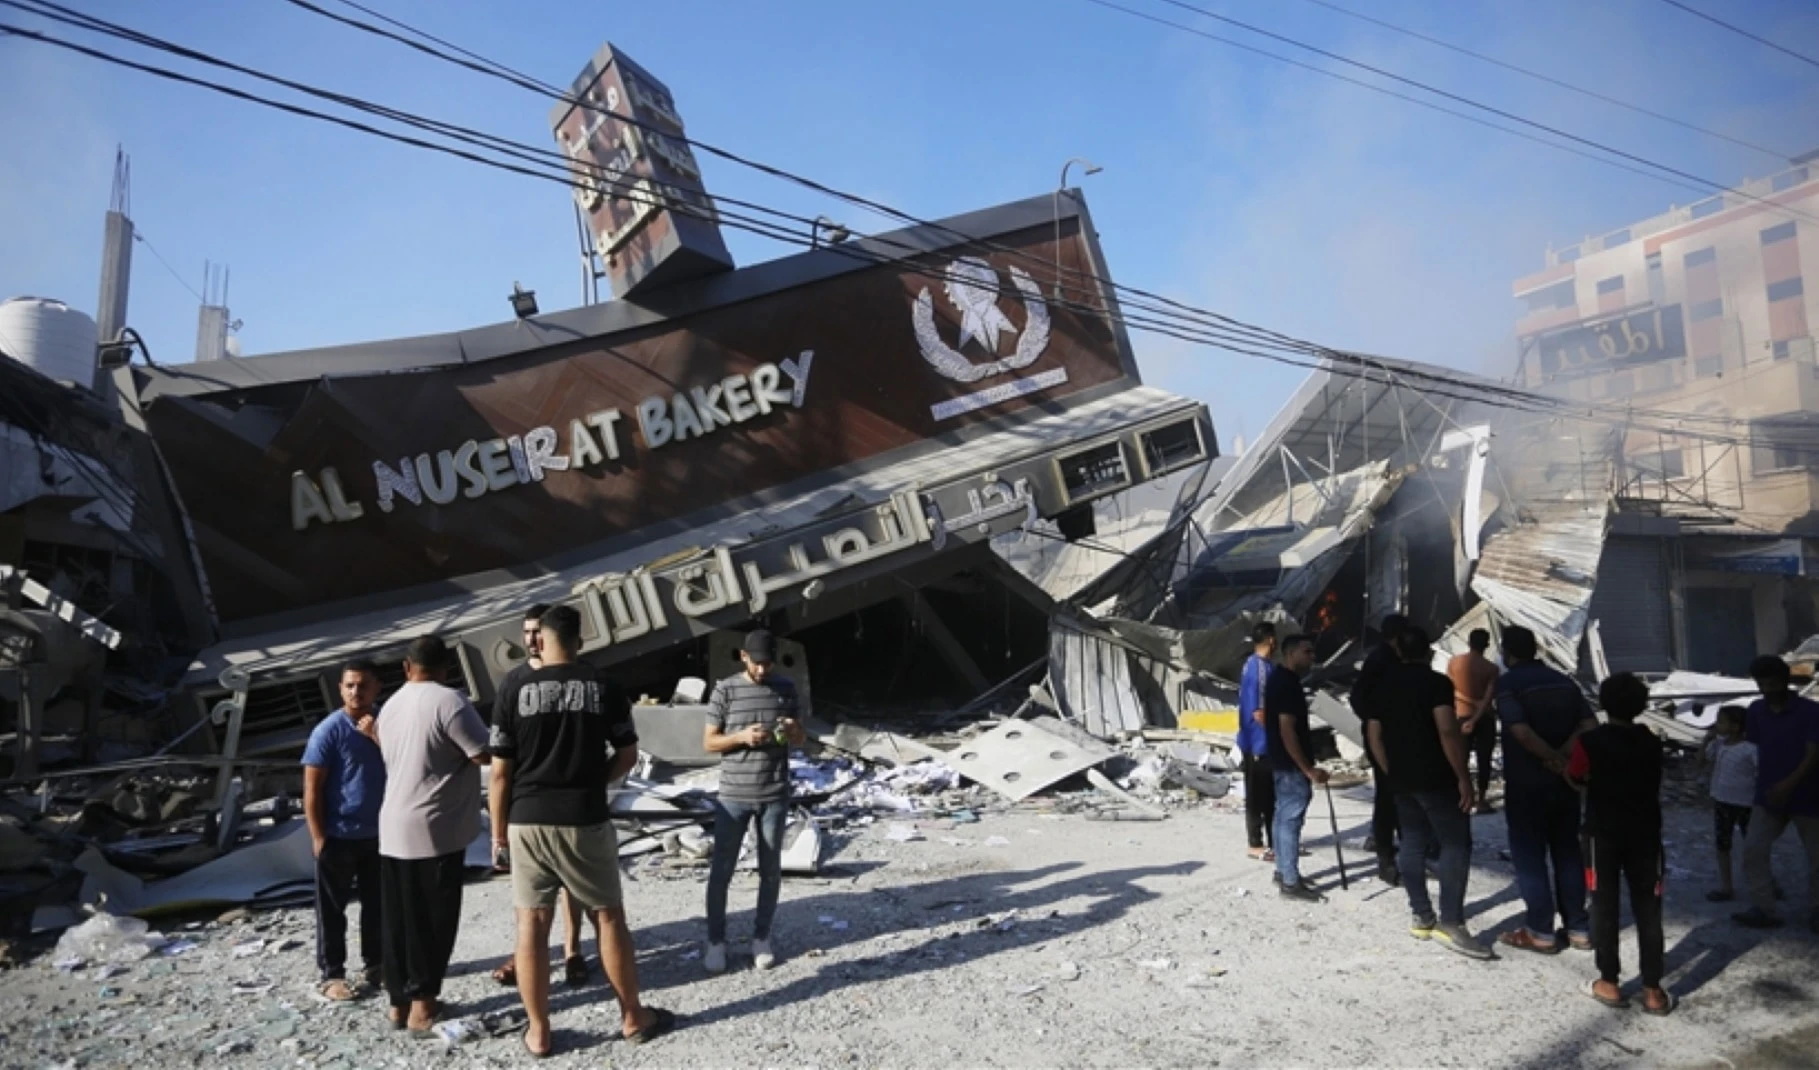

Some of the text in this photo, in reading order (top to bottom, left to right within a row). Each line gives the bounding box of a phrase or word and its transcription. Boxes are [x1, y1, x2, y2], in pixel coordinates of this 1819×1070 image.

[290, 350, 814, 530] AL NUSEIRAT BAKERY
[673, 489, 932, 613] النصيرات
